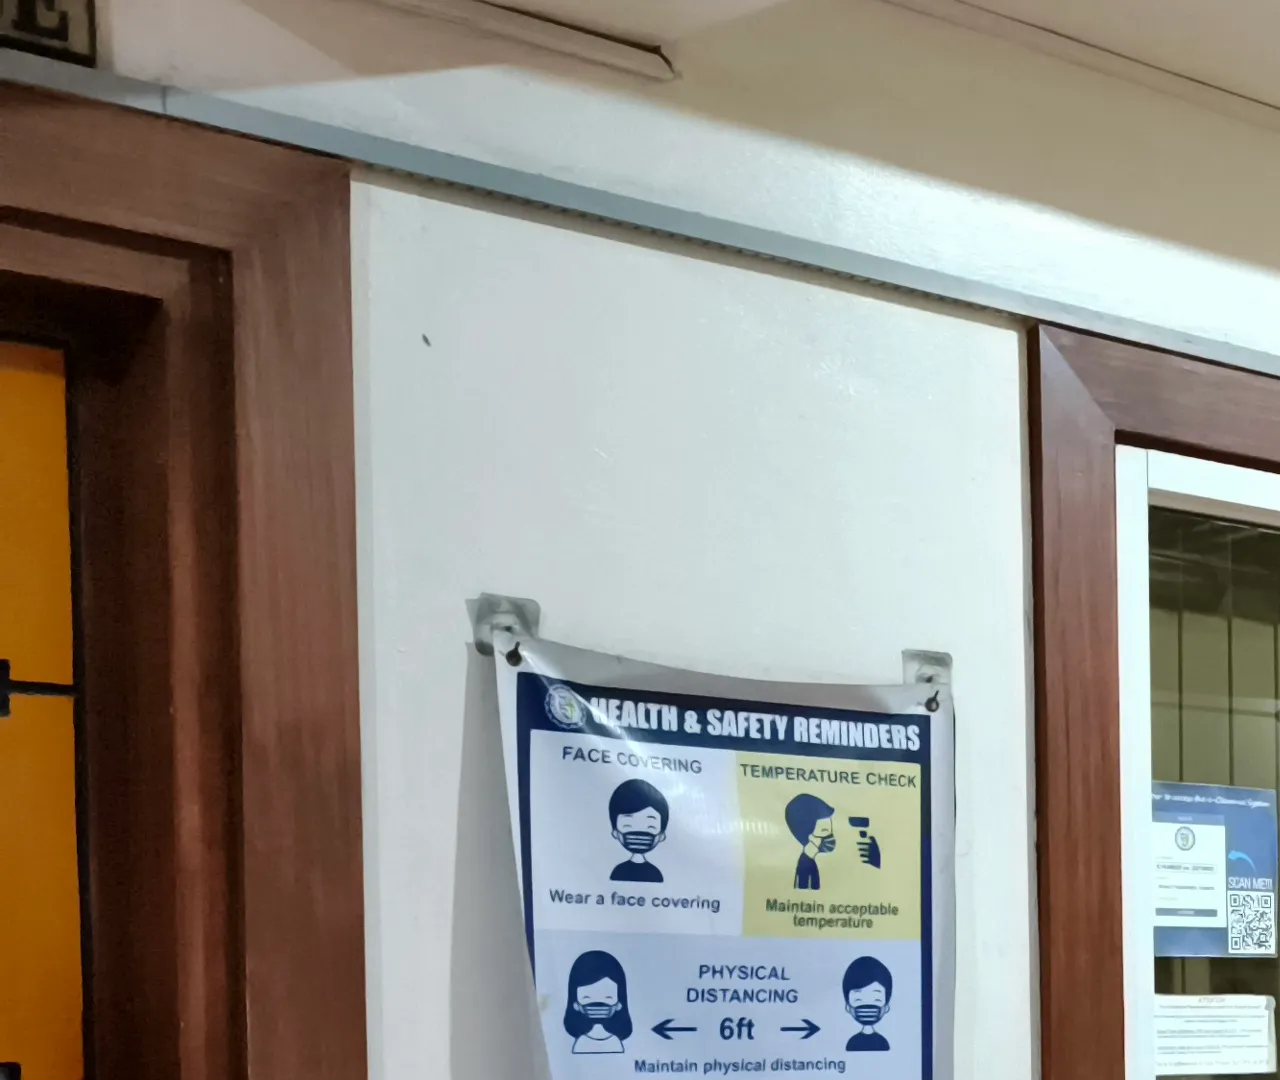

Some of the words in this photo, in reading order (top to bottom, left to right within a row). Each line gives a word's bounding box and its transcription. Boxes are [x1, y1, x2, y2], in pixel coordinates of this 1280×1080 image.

[590, 697, 679, 732] HEALTH
[683, 710, 702, 734] &
[707, 709, 787, 741] SAFETY
[793, 716, 921, 751] REMINDERS
[562, 746, 612, 764] FACE
[616, 751, 703, 774] COVERING
[740, 763, 860, 785] TEMPERATURE
[866, 772, 917, 788] CHECK
[549, 889, 592, 905] Wear
[595, 893, 605, 905] a
[611, 891, 646, 907] face
[651, 895, 721, 913] covering
[765, 898, 825, 914] Maintain
[829, 902, 899, 917] acceptable
[793, 914, 874, 930] temperature
[698, 964, 790, 981] PHYSICAL
[686, 987, 798, 1003] DISTANCING
[719, 1017, 755, 1041] 6ft
[634, 1059, 698, 1074] Maintain
[703, 1058, 766, 1076] physical
[770, 1057, 846, 1075] distancing
